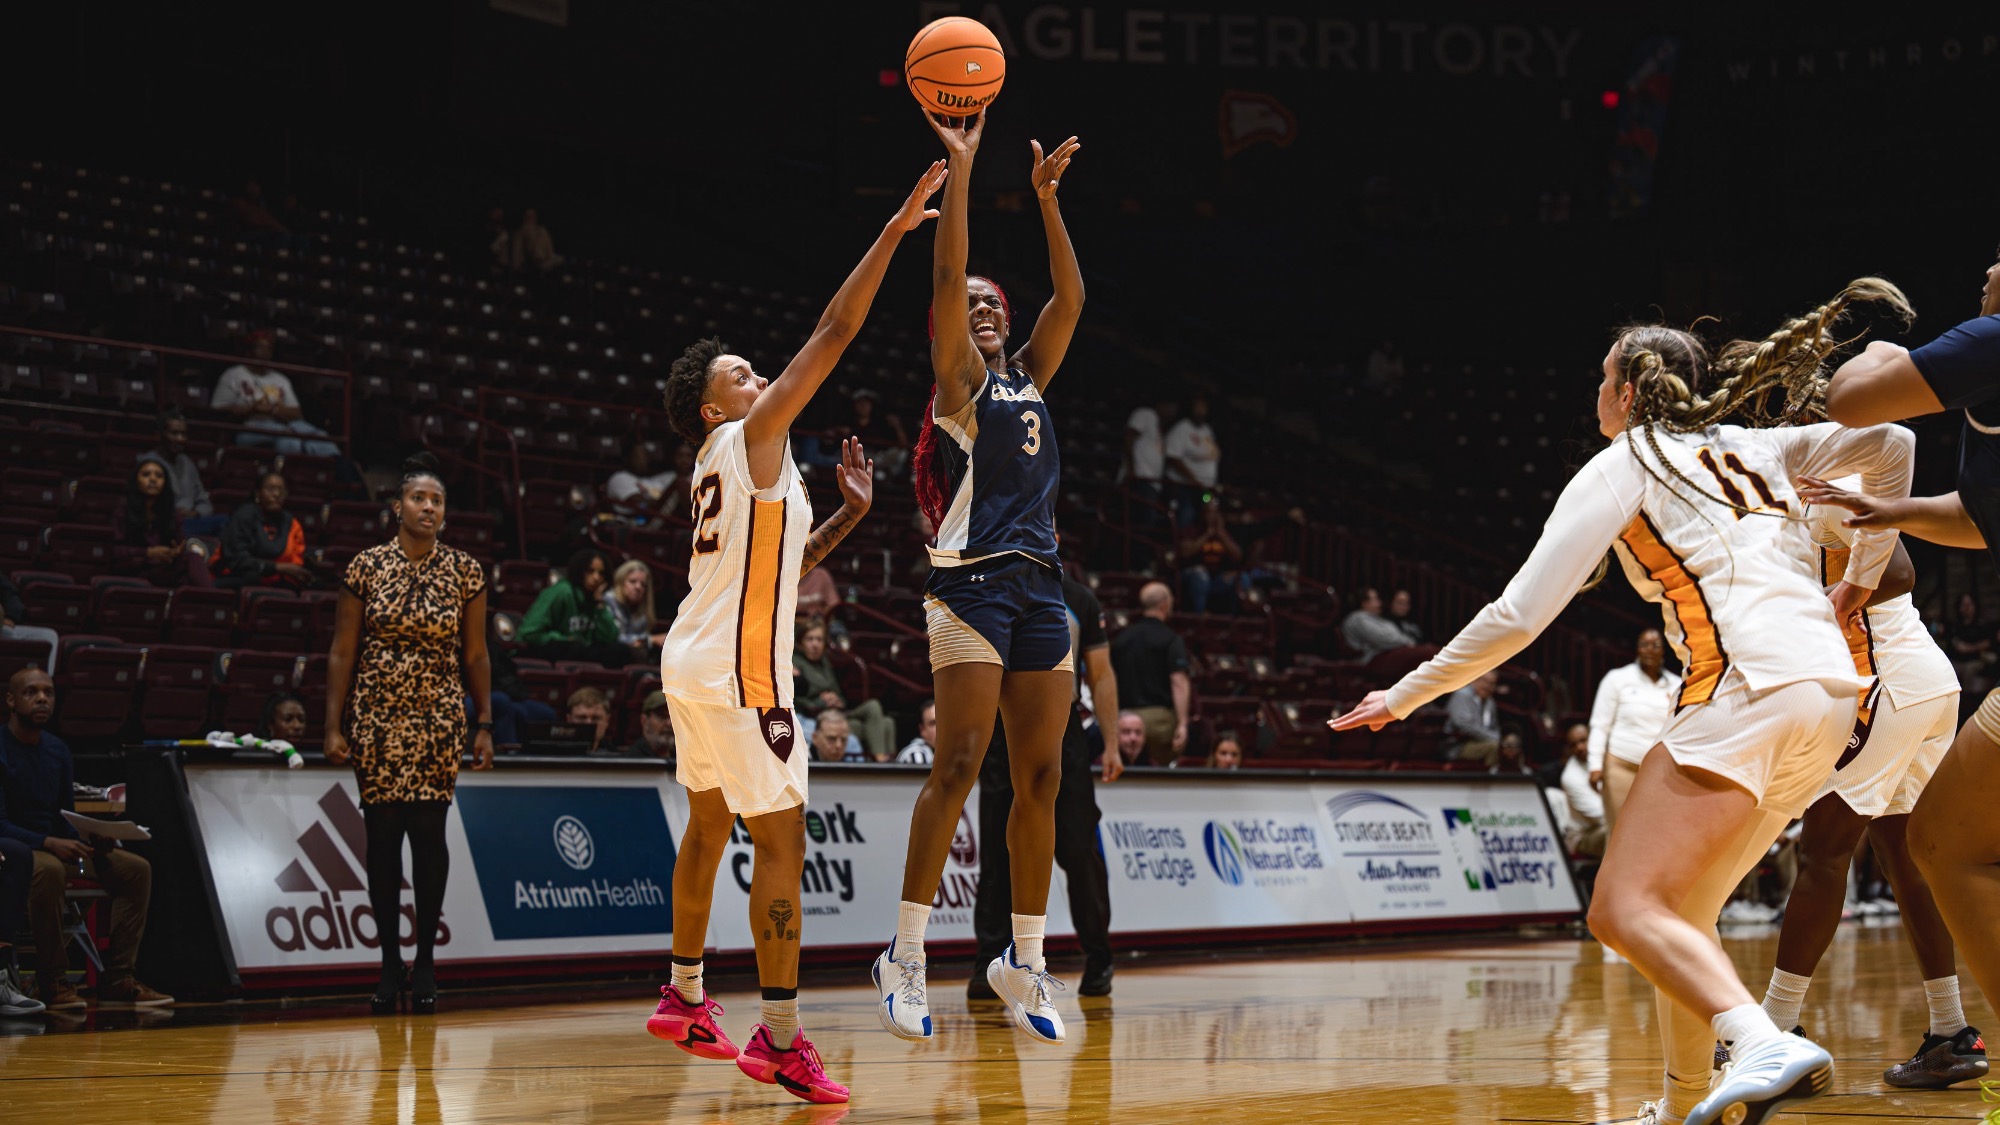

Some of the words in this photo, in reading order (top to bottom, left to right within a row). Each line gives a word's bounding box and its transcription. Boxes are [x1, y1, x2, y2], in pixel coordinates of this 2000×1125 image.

[1727, 34, 1998, 82] WINTHROP
[936, 89, 996, 108] Wilson
[1020, 410, 1041, 456] 3
[1697, 447, 1789, 521] 11
[805, 802, 866, 844] ork
[1106, 821, 1186, 849] Williams
[1232, 818, 1267, 844] York
[1266, 819, 1317, 850] County
[1334, 821, 1391, 842] STURGIS
[1390, 821, 1434, 842] BEATY
[1242, 846, 1295, 870] Natural
[1294, 845, 1324, 870] Gas
[1480, 831, 1553, 854] Education
[731, 850, 856, 903] Cnty
[1486, 856, 1555, 889] Lottery
